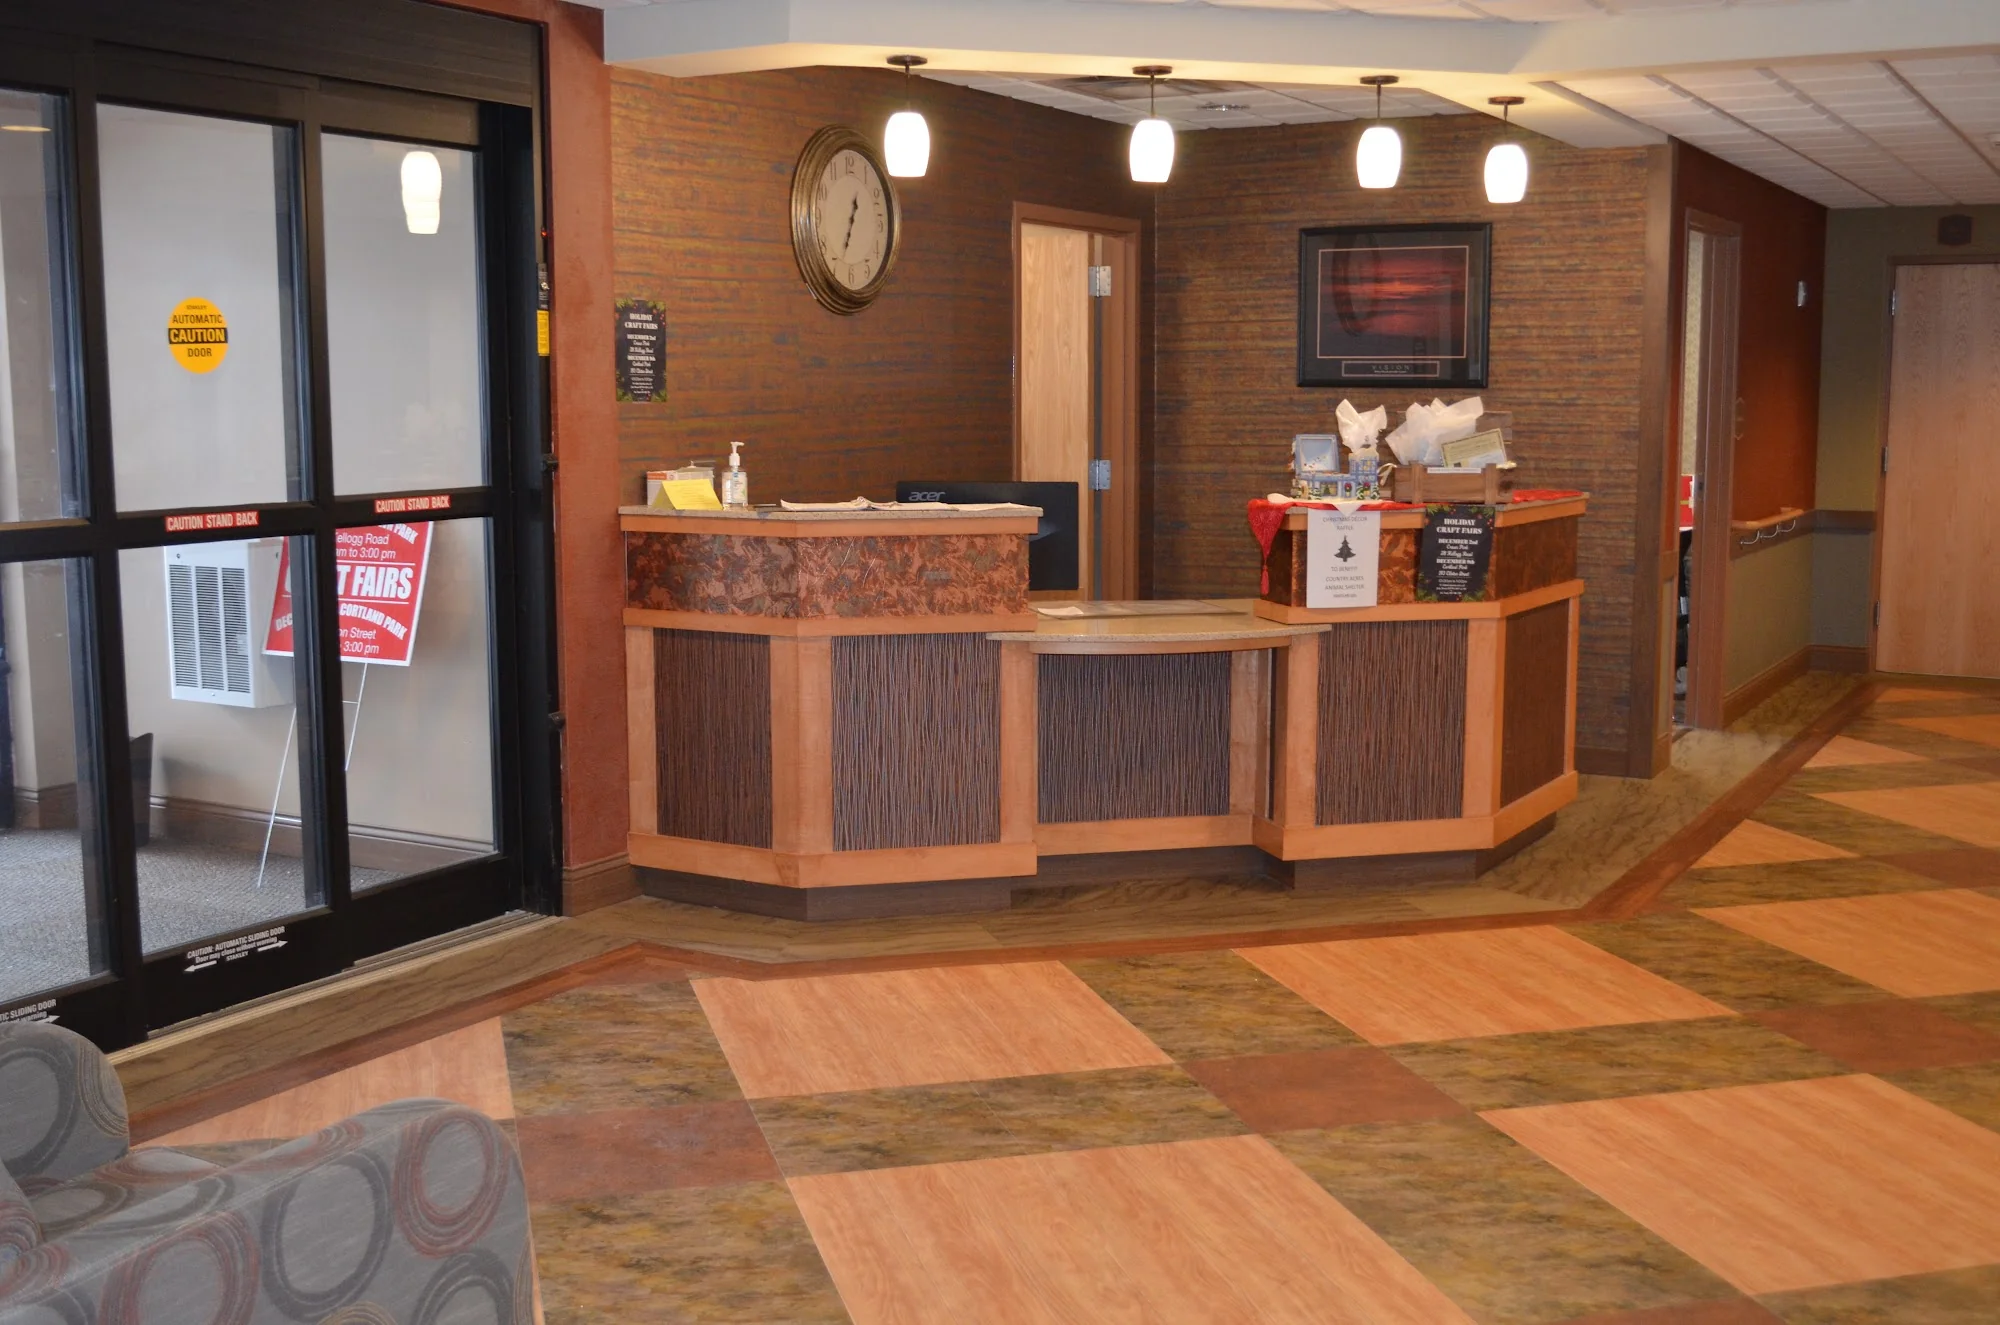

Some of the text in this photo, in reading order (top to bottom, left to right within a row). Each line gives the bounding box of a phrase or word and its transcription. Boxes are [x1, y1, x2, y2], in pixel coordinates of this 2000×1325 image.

[172, 314, 223, 324] AUTOMATIC
[629, 313, 653, 321] HOLIDAY
[624, 321, 642, 329] CRAFT
[169, 328, 226, 343] CAUTION
[187, 348, 212, 357] DOOR
[908, 491, 946, 501] acer
[375, 495, 450, 513] CAUTION STAND BACK
[166, 511, 258, 531] CAUTION STAND BACK
[1443, 518, 1476, 526] HOLIDAY
[336, 532, 390, 546] ellogg Road
[393, 523, 418, 544] PARK
[349, 547, 358, 557] to
[360, 547, 380, 558] 3:00
[381, 550, 396, 560] pm
[351, 565, 414, 599] FAIRS
[339, 603, 385, 626] CORTLAND
[383, 615, 408, 640] PARK
[350, 627, 377, 639] Street
[343, 641, 380, 655] 3:00 pm
[214, 936, 248, 951] AUTOMATIC
[248, 930, 270, 942] SLIDING
[269, 925, 286, 936] DOOR
[195, 955, 209, 964] Door
[221, 948, 235, 957] close
[236, 942, 256, 952] without
[226, 951, 249, 961] STANLEY
[10, 1004, 37, 1019] SLIDING
[38, 999, 57, 1011] DOOR
